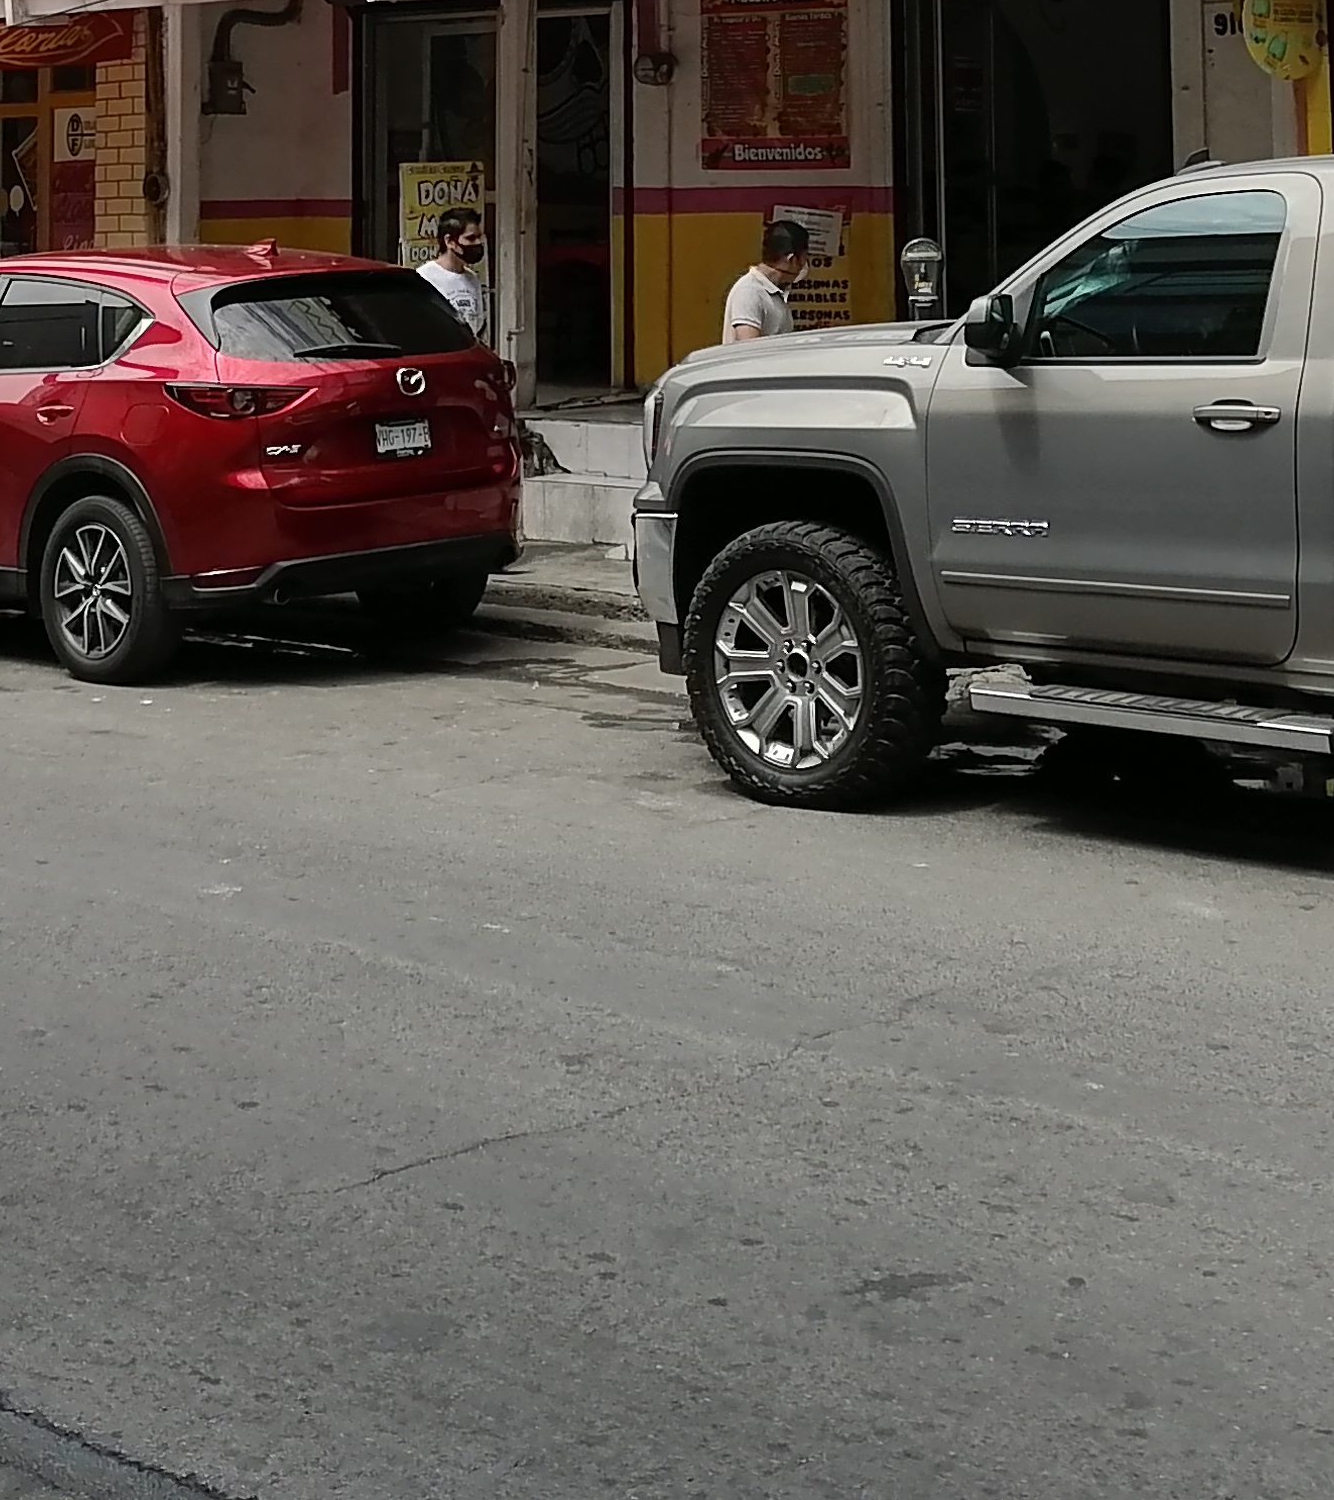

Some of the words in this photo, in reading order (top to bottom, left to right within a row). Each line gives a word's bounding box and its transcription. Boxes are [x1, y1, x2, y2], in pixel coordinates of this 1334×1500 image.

[733, 144, 823, 162] Bienvenidos
[418, 177, 477, 206] DOÑA
[788, 280, 849, 290] ERSONAS
[792, 310, 850, 320] ERSONAS
